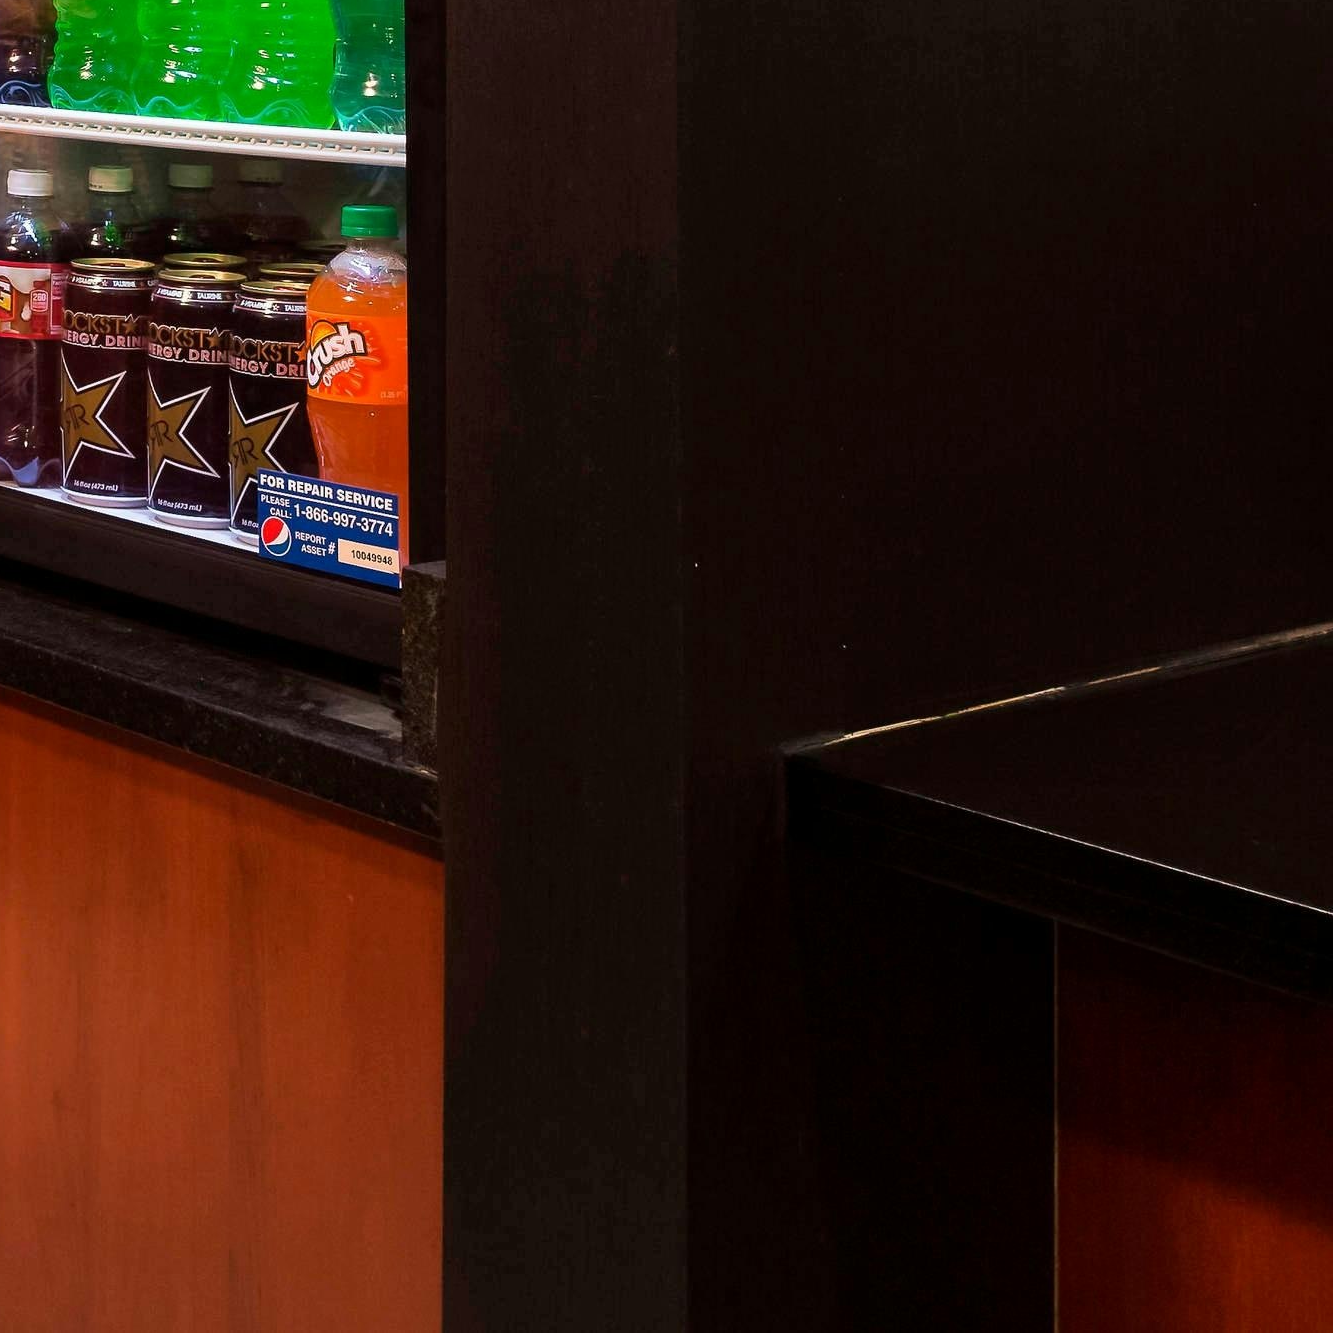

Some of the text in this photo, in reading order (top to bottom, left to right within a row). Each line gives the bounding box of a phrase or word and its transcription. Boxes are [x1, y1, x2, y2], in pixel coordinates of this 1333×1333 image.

[307, 324, 365, 387] Crush
[322, 357, 355, 387] Orange
[259, 473, 394, 512] FOR REPAIR SERVICE
[260, 494, 290, 508] PLEASE
[269, 506, 293, 519] CALL:
[294, 503, 394, 538] 1-866-997-3774
[295, 531, 327, 546] REPORT
[301, 542, 336, 557] ASSET #
[350, 549, 394, 566] 10049948
